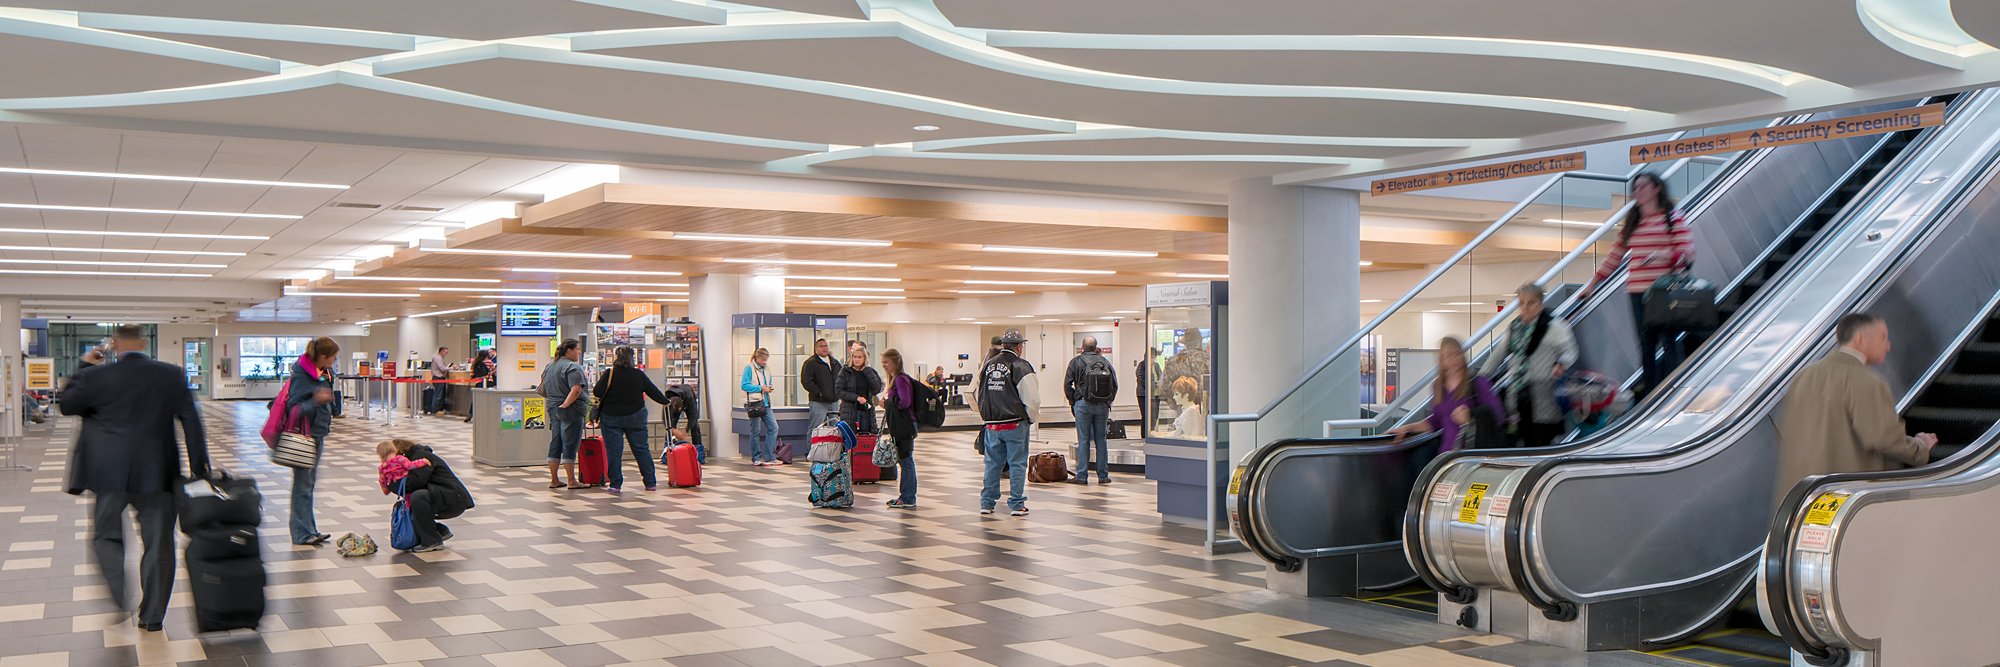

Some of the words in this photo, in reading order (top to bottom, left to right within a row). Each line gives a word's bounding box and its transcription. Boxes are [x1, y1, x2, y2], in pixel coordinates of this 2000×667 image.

[1766, 125, 1831, 144] Security
[1835, 113, 1921, 135] Screening
[1652, 145, 1671, 158] All
[1674, 140, 1715, 156] Gates
[1388, 176, 1428, 191] Elevator
[1456, 163, 1545, 182] Ticketing/Check
[1549, 159, 1562, 169] In
[1180, 286, 1198, 297] Salon
